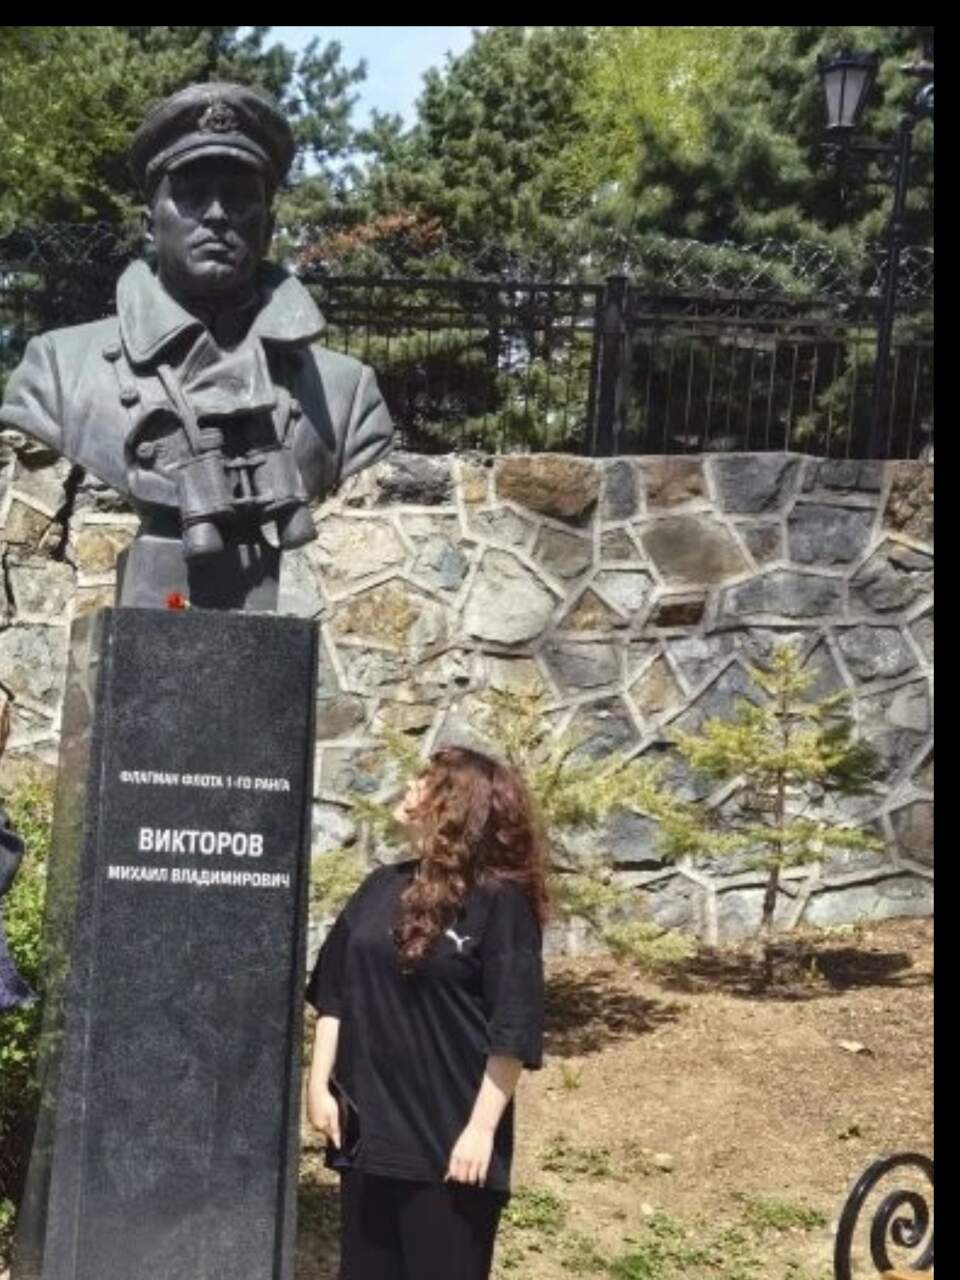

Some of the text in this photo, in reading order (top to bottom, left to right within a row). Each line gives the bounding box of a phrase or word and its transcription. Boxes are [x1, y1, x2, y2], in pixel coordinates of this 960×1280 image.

[119, 770, 290, 792] ФЛАГМАН ФЛОТА 1-ГО РАНГА
[140, 828, 263, 857] ВИКТОРОВ
[108, 865, 290, 888] МИХАИЛ ВЛАДИМИРОВИЧ
